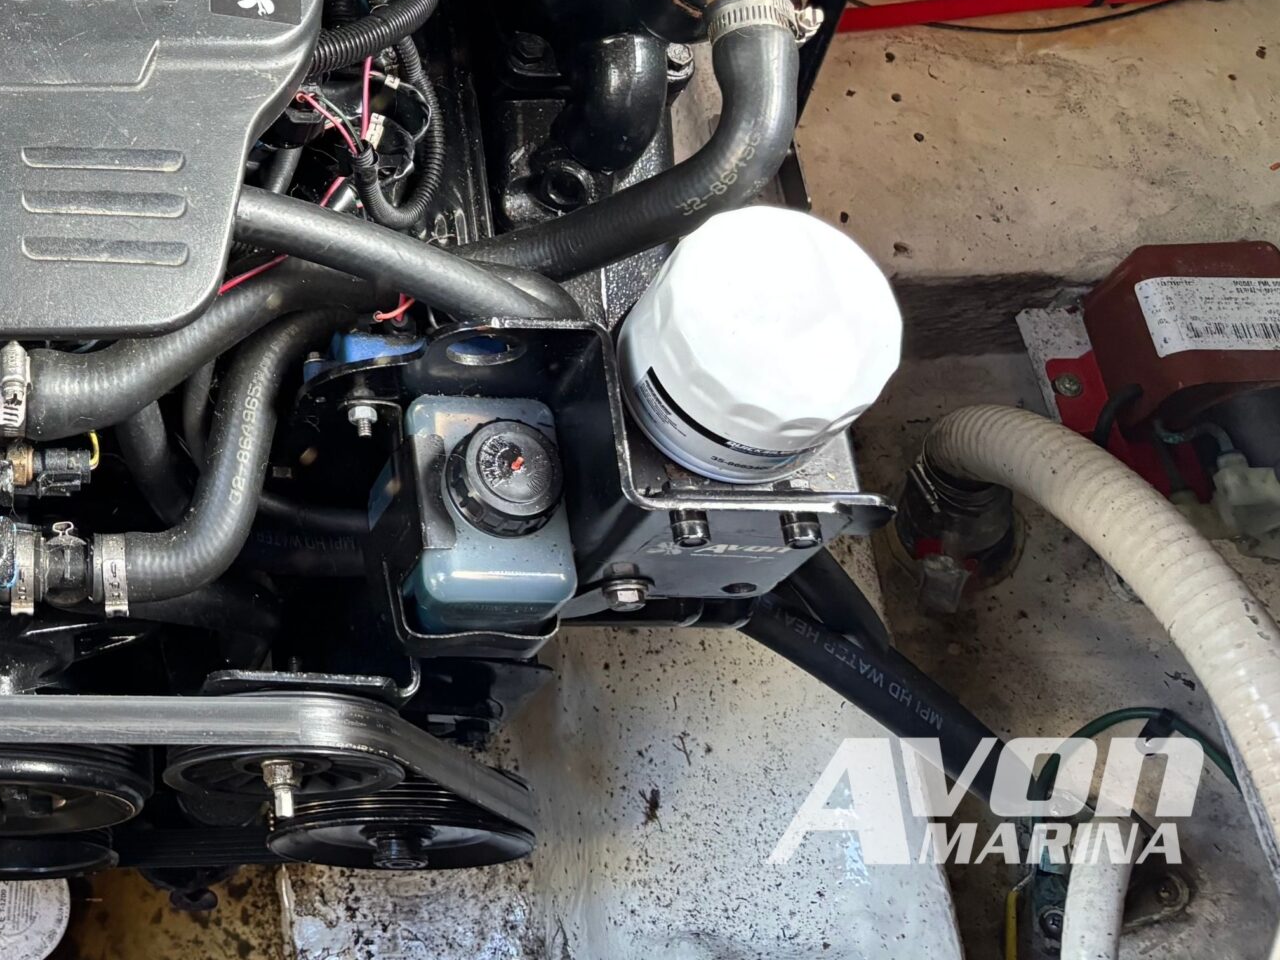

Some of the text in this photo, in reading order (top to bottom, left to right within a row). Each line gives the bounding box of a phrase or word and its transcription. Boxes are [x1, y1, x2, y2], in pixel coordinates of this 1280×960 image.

[822, 640, 885, 686] WATER
[886, 682, 915, 707] HD
[913, 702, 944, 730] MPI
